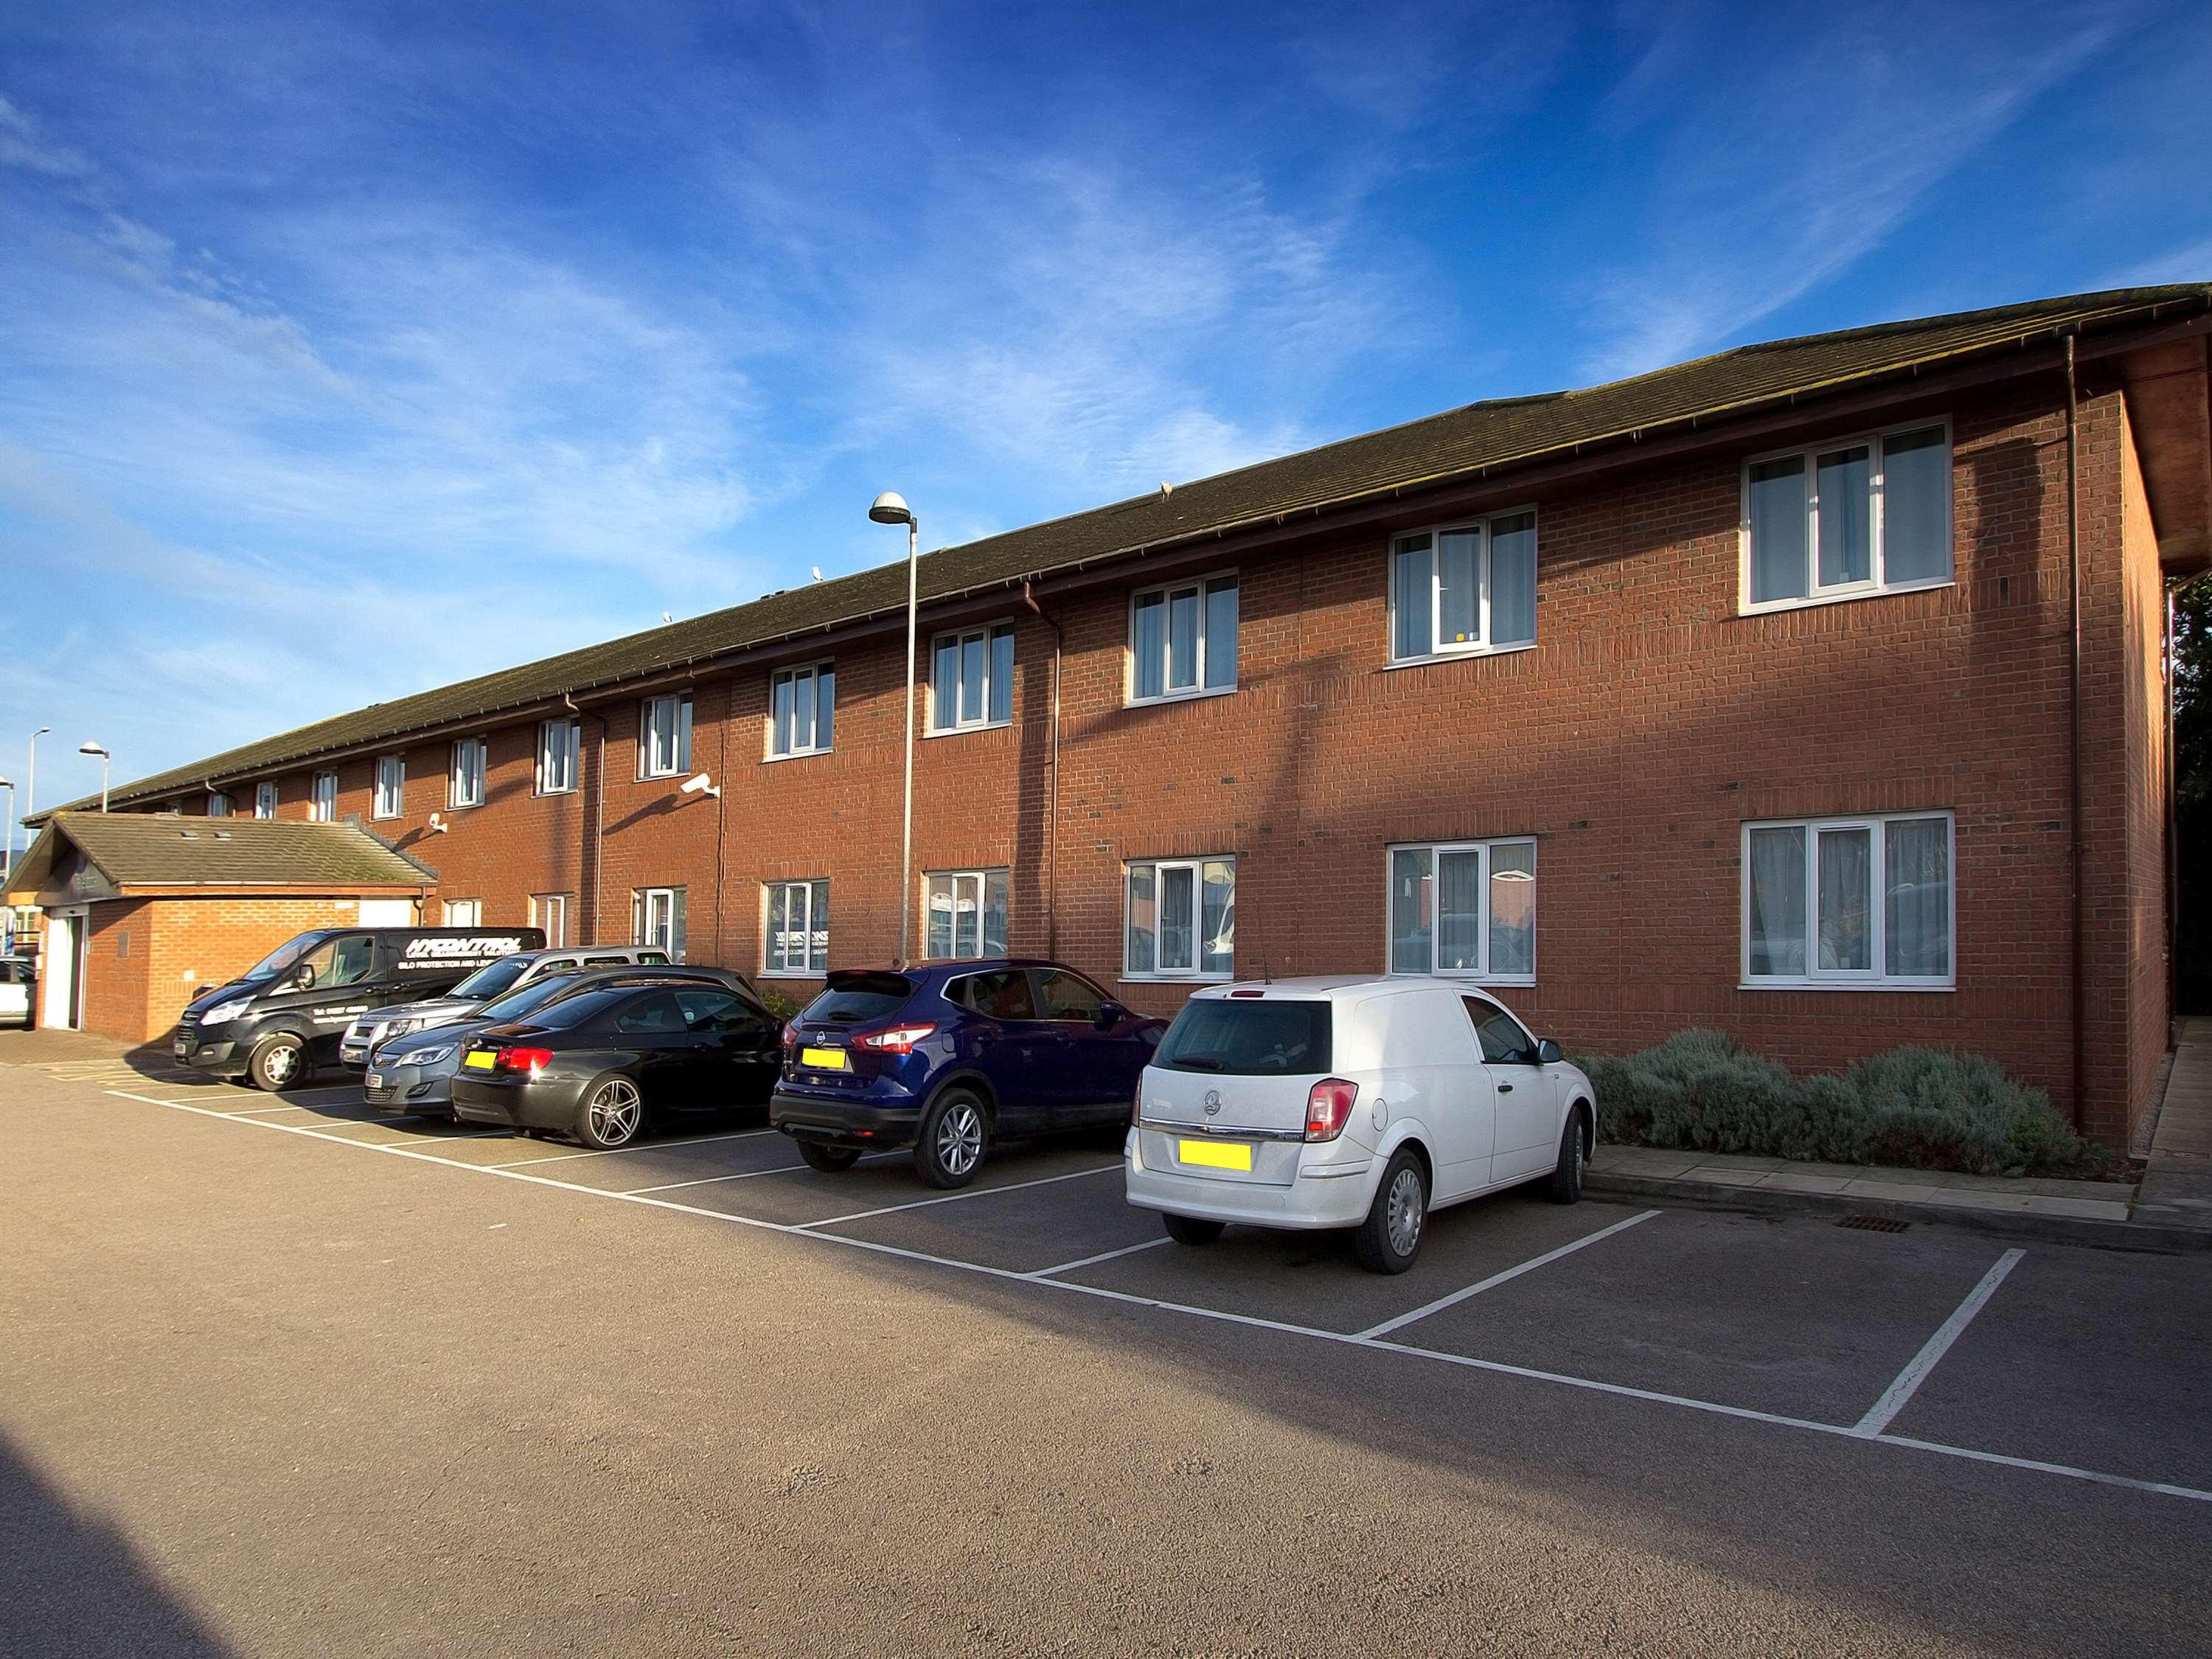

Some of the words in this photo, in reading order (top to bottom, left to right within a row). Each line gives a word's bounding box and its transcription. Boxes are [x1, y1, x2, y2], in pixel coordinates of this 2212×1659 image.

[406, 938, 521, 952] HYCONTROL
[397, 961, 415, 970] SILO
[416, 961, 460, 969] PROTECTION
[461, 960, 476, 968] AND
